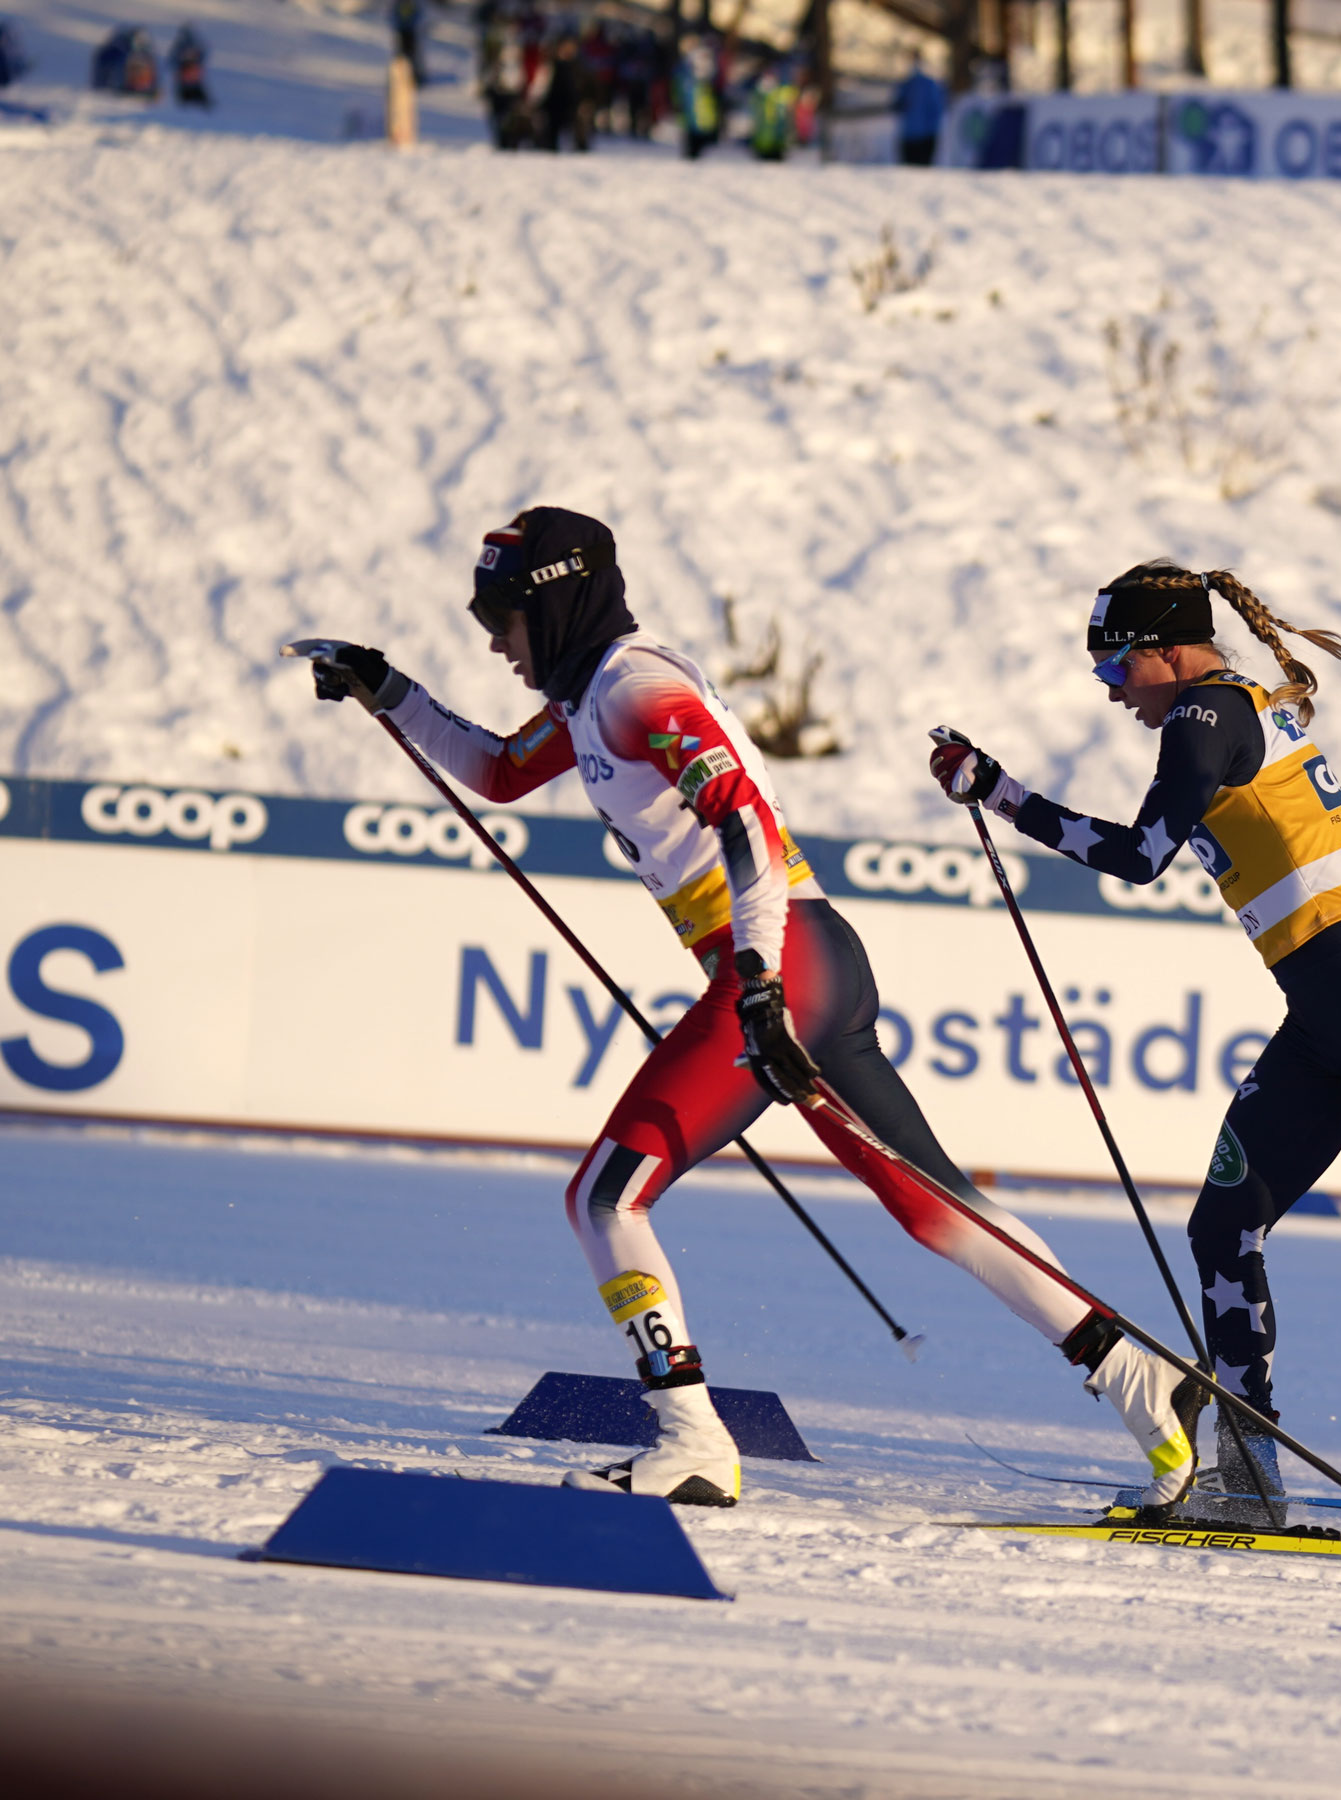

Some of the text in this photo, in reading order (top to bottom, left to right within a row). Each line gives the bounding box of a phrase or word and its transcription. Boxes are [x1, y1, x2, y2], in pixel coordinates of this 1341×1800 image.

[1033, 119, 1156, 174] OBOS
[82, 786, 268, 852] coop
[343, 803, 529, 870] coop
[843, 840, 1029, 907] coop
[1227, 871, 1241, 885] CUP
[0, 921, 125, 1094] S
[625, 1310, 673, 1358] 16
[1107, 1530, 1257, 1549] FISCHER
